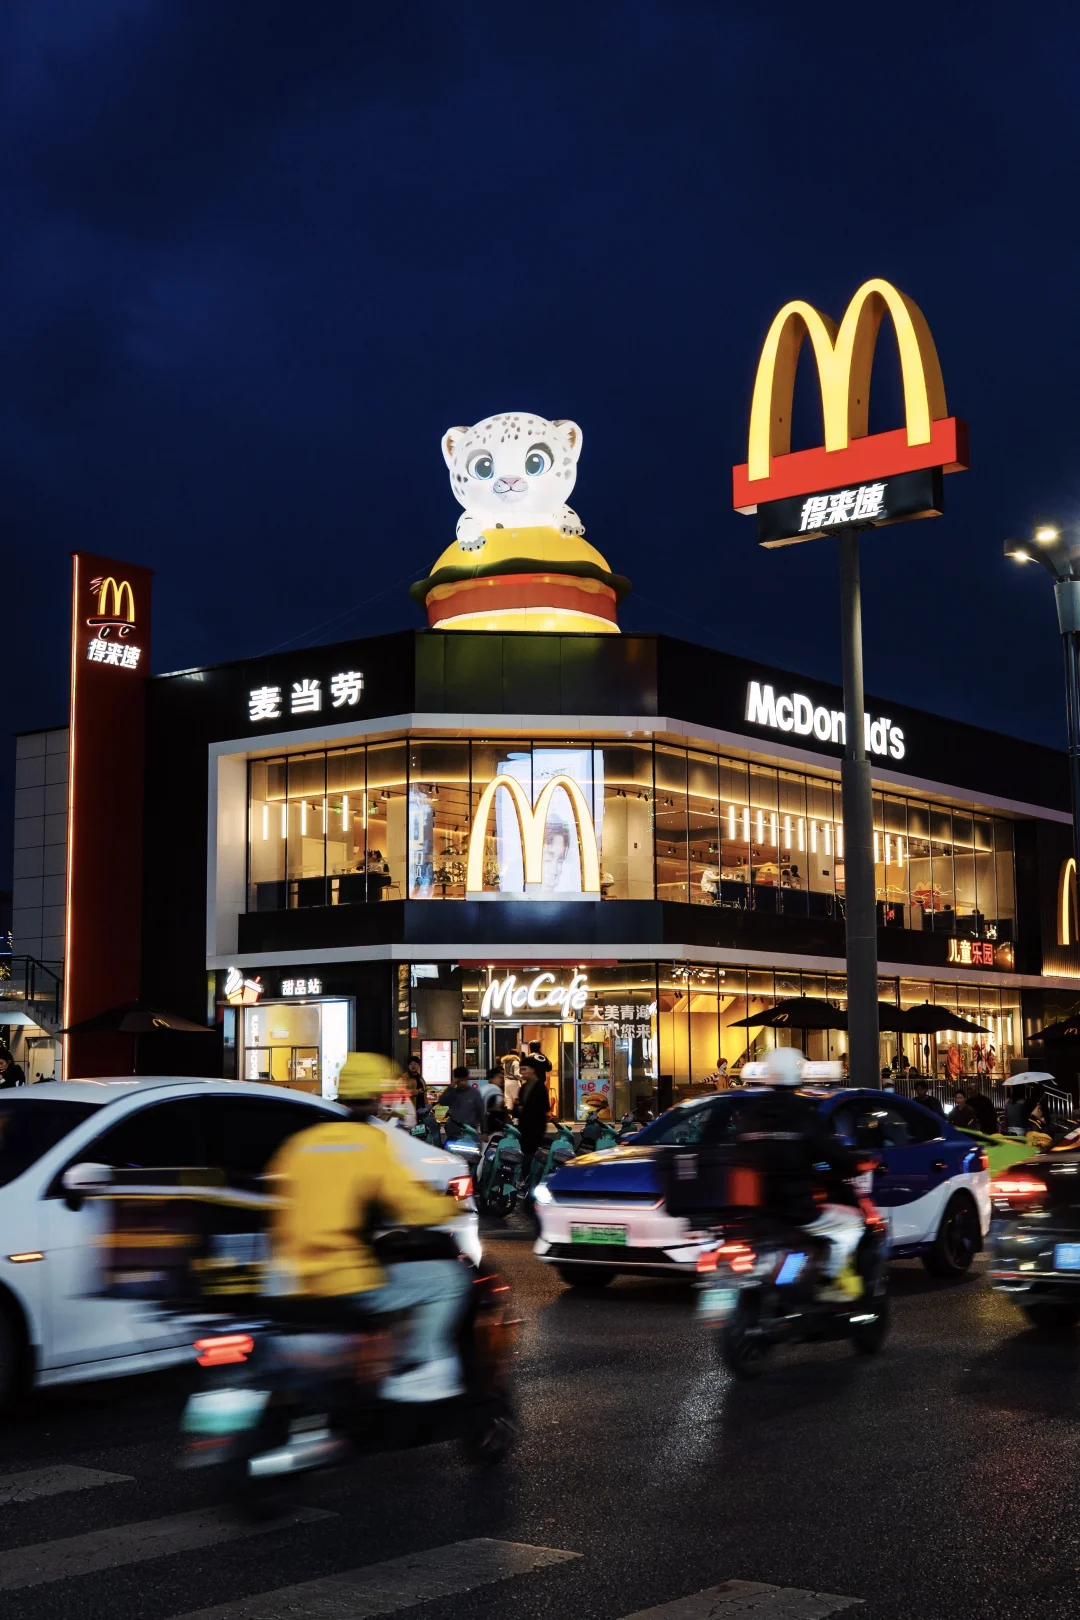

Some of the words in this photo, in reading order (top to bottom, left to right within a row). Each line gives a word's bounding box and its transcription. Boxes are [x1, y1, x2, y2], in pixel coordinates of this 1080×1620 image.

[798, 482, 888, 532] 得来速
[87, 639, 141, 669] 得来速
[248, 671, 364, 721] 麦当劳
[745, 681, 905, 760] McDonld's
[949, 939, 993, 966] 儿童乐园
[282, 978, 322, 996] 甜品站
[481, 973, 589, 1018] McCafé
[589, 1005, 652, 1020] 大美青海
